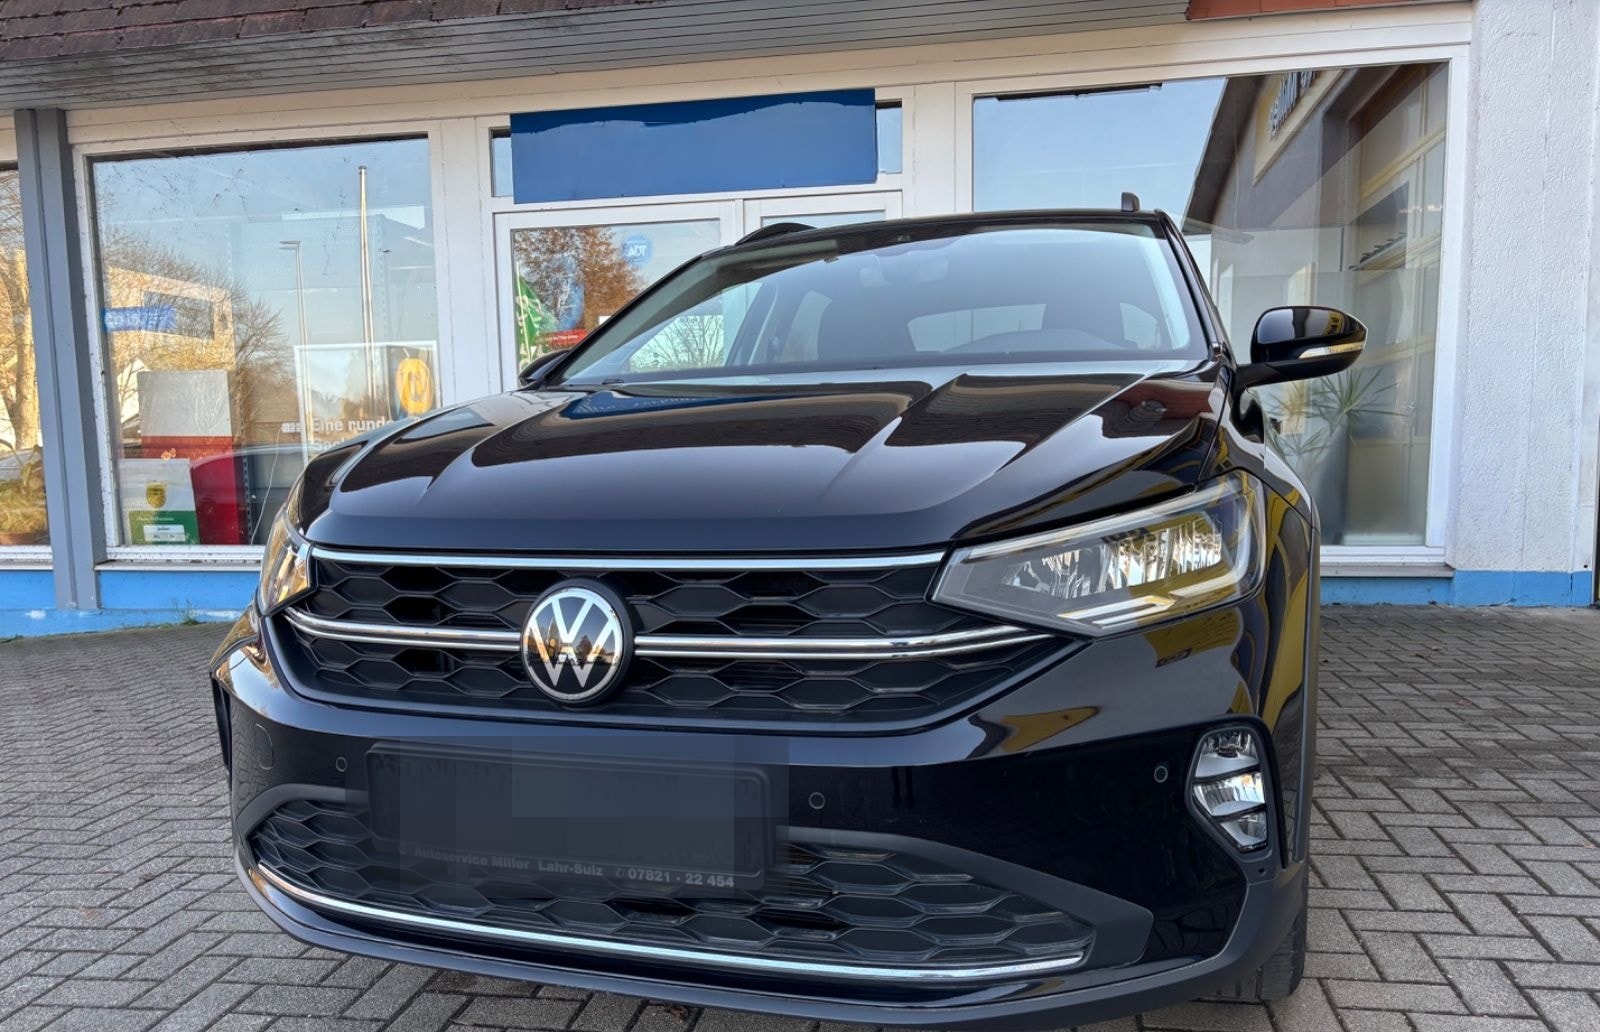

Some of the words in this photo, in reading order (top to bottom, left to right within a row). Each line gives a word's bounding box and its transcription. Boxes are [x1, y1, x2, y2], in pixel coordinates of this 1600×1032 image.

[312, 417, 343, 432] Eine
[523, 588, 623, 700] VW
[414, 847, 488, 866] Autoservice
[491, 856, 530, 870] Miller
[538, 860, 604, 877] Lahr-Sulz
[628, 868, 670, 882] 07821
[685, 873, 703, 885] 22
[707, 875, 735, 888] 454
